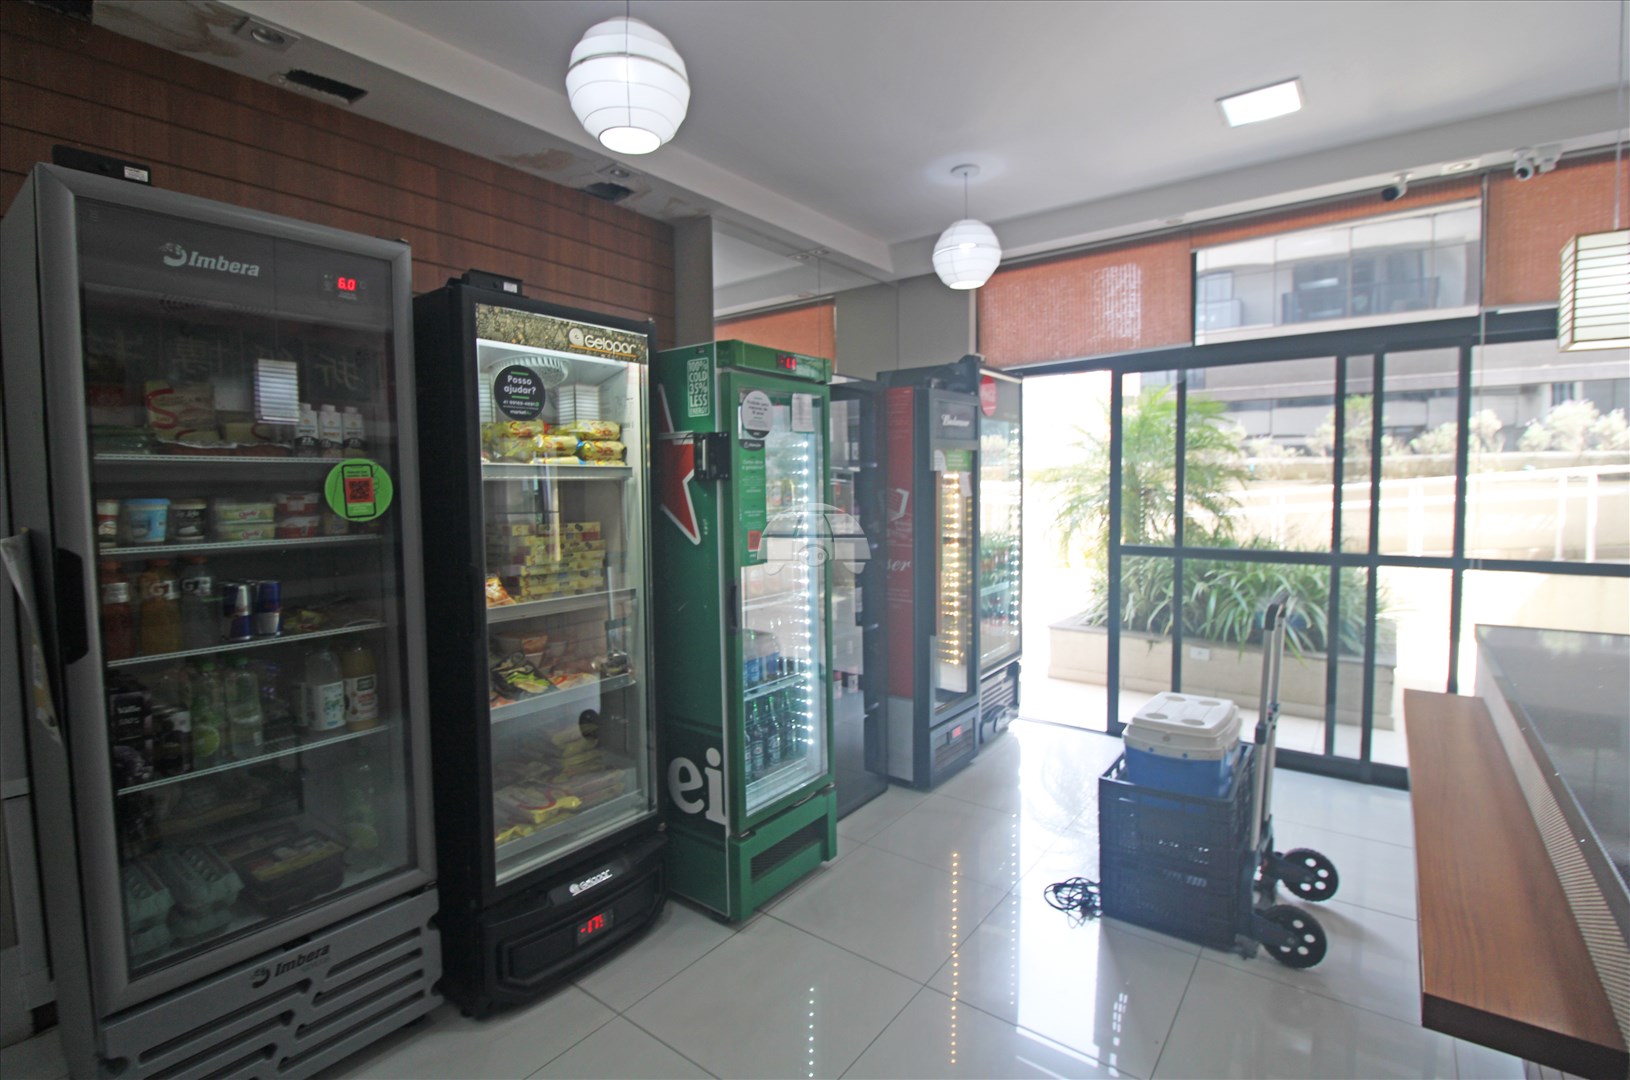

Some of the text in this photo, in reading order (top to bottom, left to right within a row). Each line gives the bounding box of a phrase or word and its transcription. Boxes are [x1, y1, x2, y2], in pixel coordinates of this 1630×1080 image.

[187, 249, 260, 278] Imbera
[584, 333, 636, 355] Gelopar
[507, 374, 532, 386] Posso
[689, 371, 707, 382] COLD
[503, 384, 537, 396] ajudar?
[689, 383, 707, 394] 35%
[690, 394, 707, 407] LESS
[274, 943, 332, 978] Imbera
